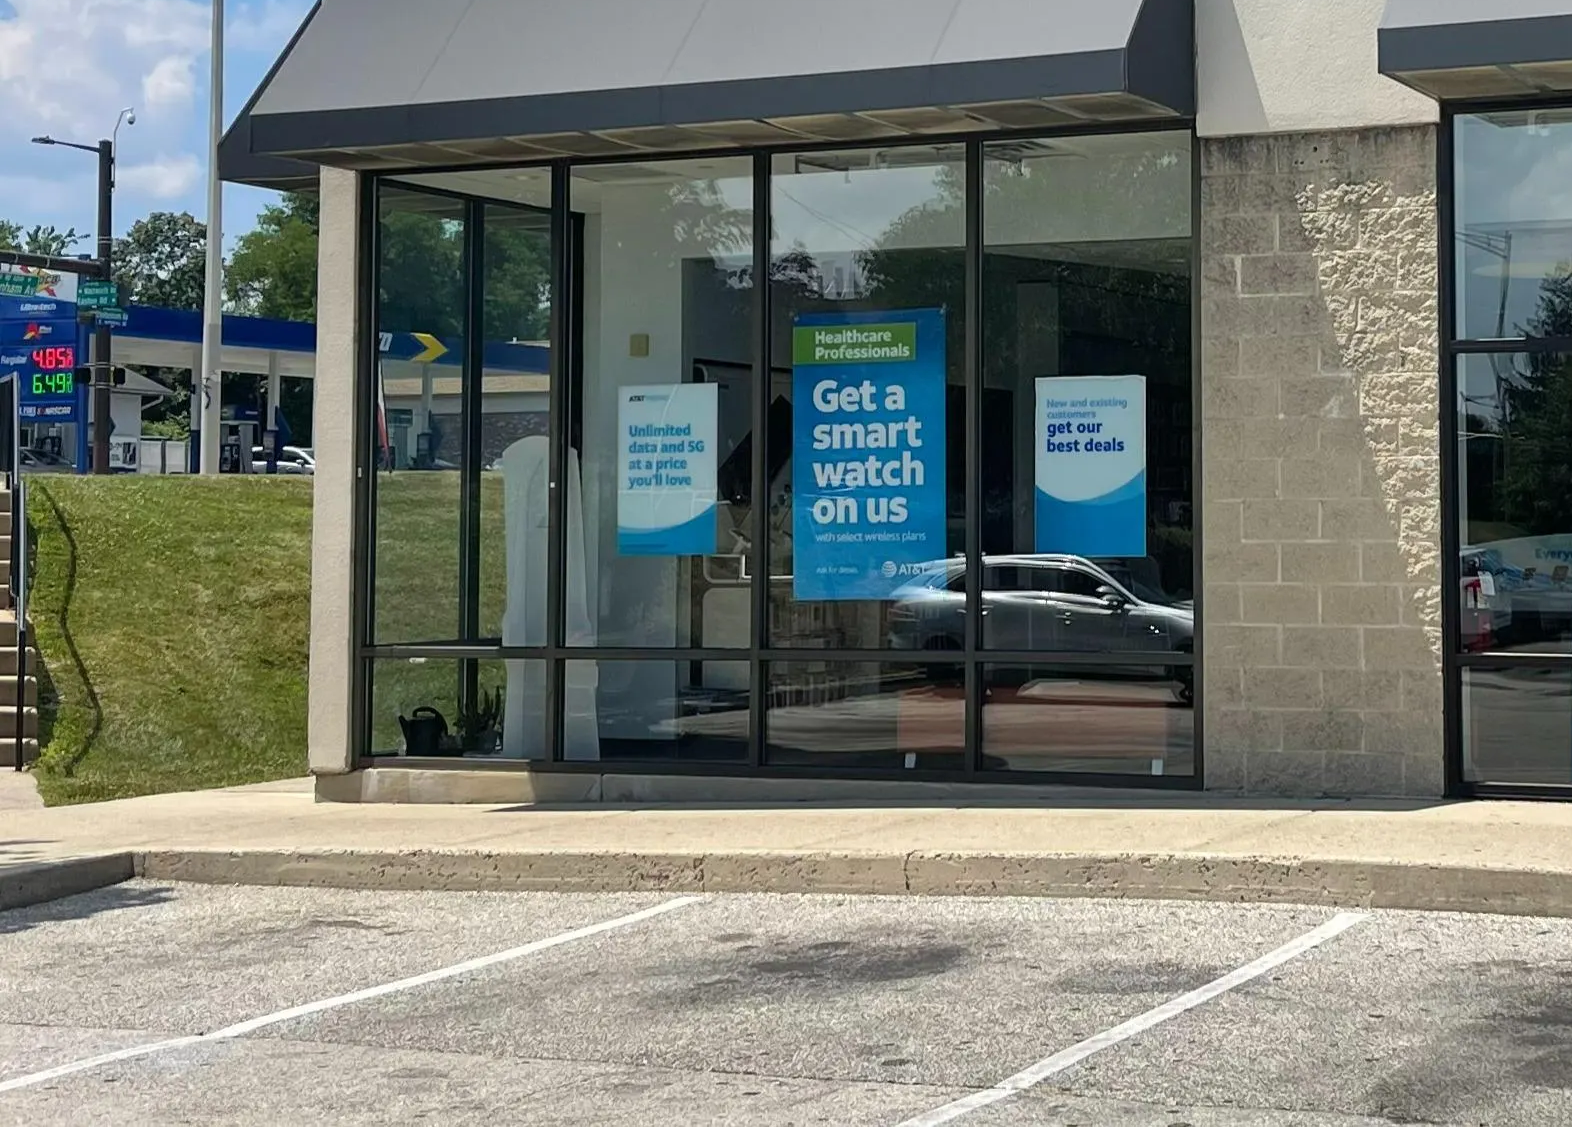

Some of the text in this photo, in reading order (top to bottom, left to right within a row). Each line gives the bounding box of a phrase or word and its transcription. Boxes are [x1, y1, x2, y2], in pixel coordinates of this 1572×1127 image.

[815, 330, 892, 345] Healthcare
[815, 343, 910, 360] Professionals
[813, 380, 905, 412] Get a
[1047, 397, 1128, 409] New and existing
[1047, 410, 1096, 419] customers
[629, 424, 691, 438] Unlimited
[813, 416, 922, 450] smart
[1047, 421, 1103, 438] get our
[629, 440, 704, 454] data and 5G
[1047, 437, 1124, 453] best deals
[629, 458, 687, 473] at a price
[812, 451, 924, 488] watch
[628, 473, 691, 489] you'll love
[813, 496, 908, 524] on us
[816, 531, 926, 544] with select wireless plans
[898, 563, 925, 576] AT&T
